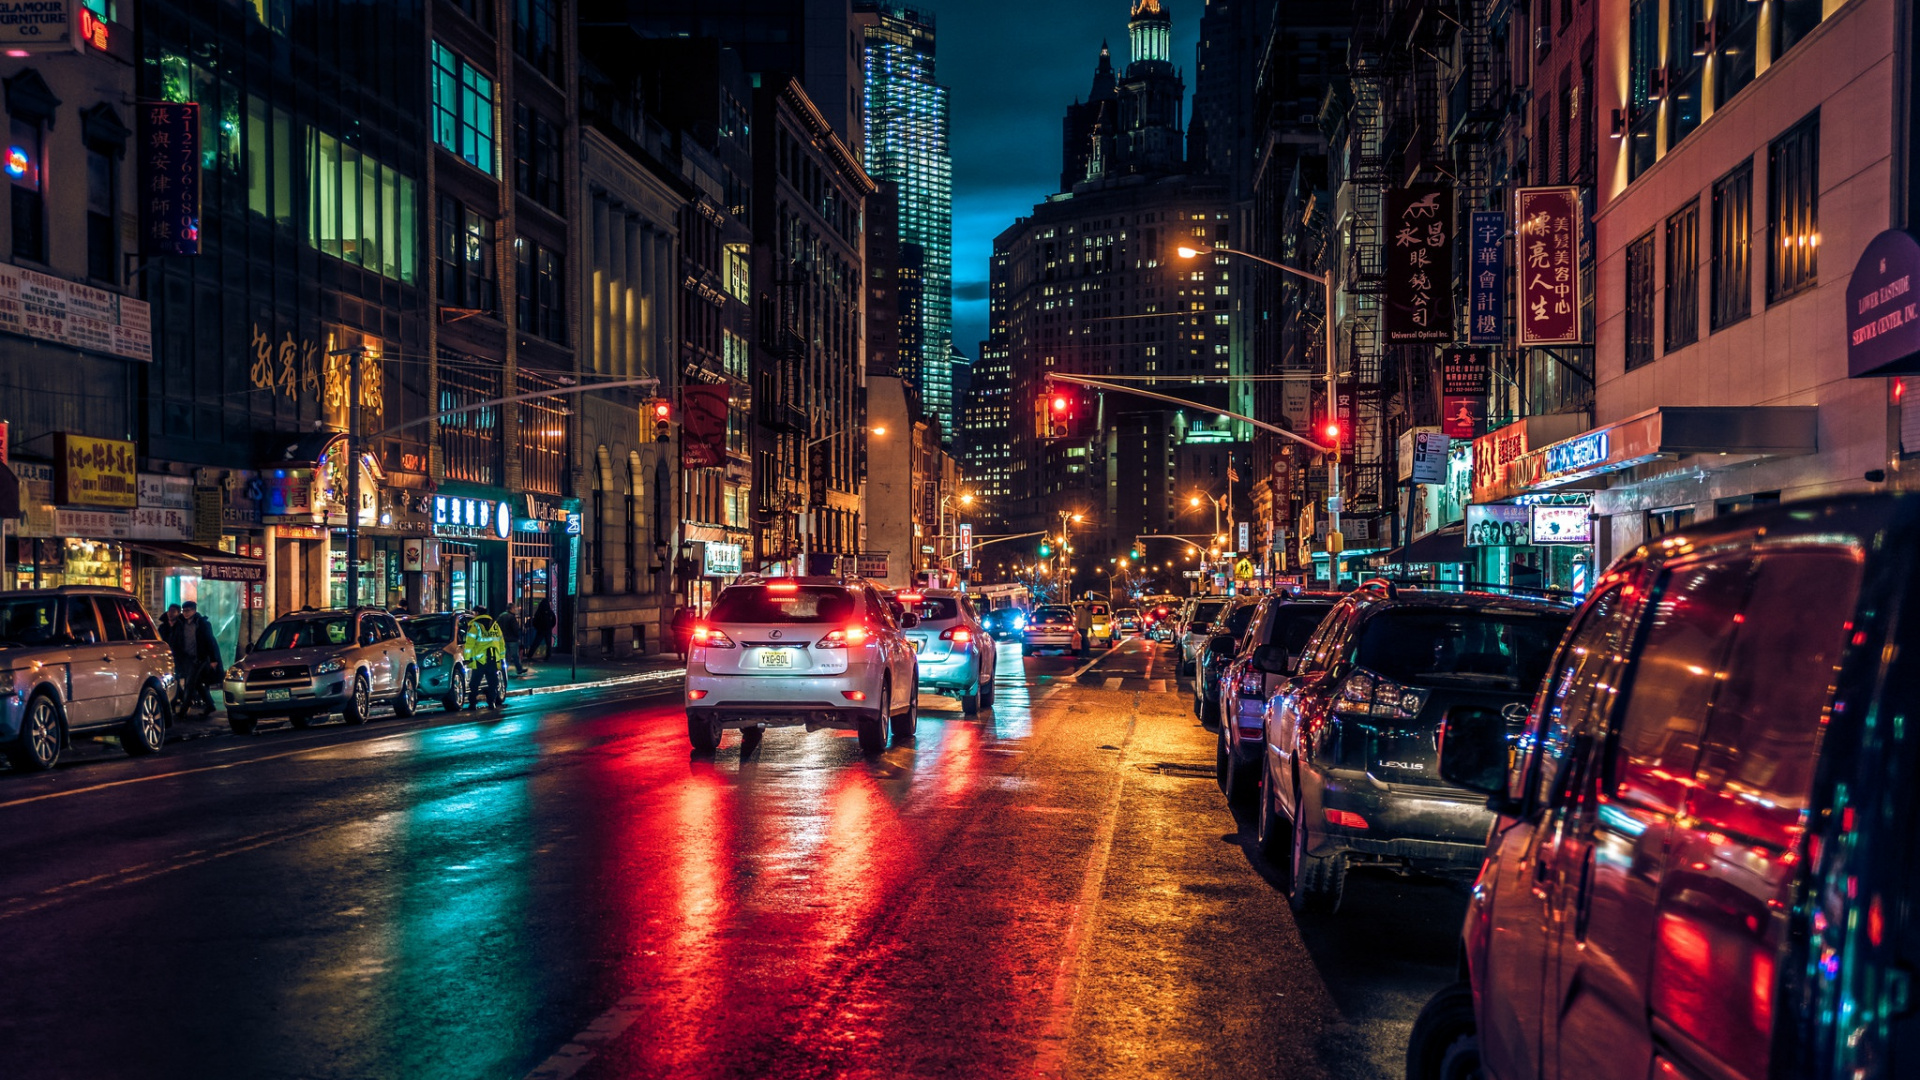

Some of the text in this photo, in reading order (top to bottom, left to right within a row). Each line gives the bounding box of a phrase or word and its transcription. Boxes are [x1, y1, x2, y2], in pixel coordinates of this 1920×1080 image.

[0, 13, 67, 25] URNITURE
[19, 25, 42, 35] CO.
[1528, 210, 1554, 322] 漂亮人生
[1554, 216, 1571, 315] 美髮美容中心
[1858, 274, 1910, 315] LOWER EASTSIDE
[1852, 321, 1877, 346] SERVICE
[1904, 302, 1919, 324] INC.
[1391, 331, 1417, 340] Universal
[1418, 331, 1438, 341] Optical
[223, 508, 261, 521] CENTER
[399, 521, 426, 531] CENTER
[962, 529, 970, 568] DINER
[1378, 759, 1424, 770] LEXUS
